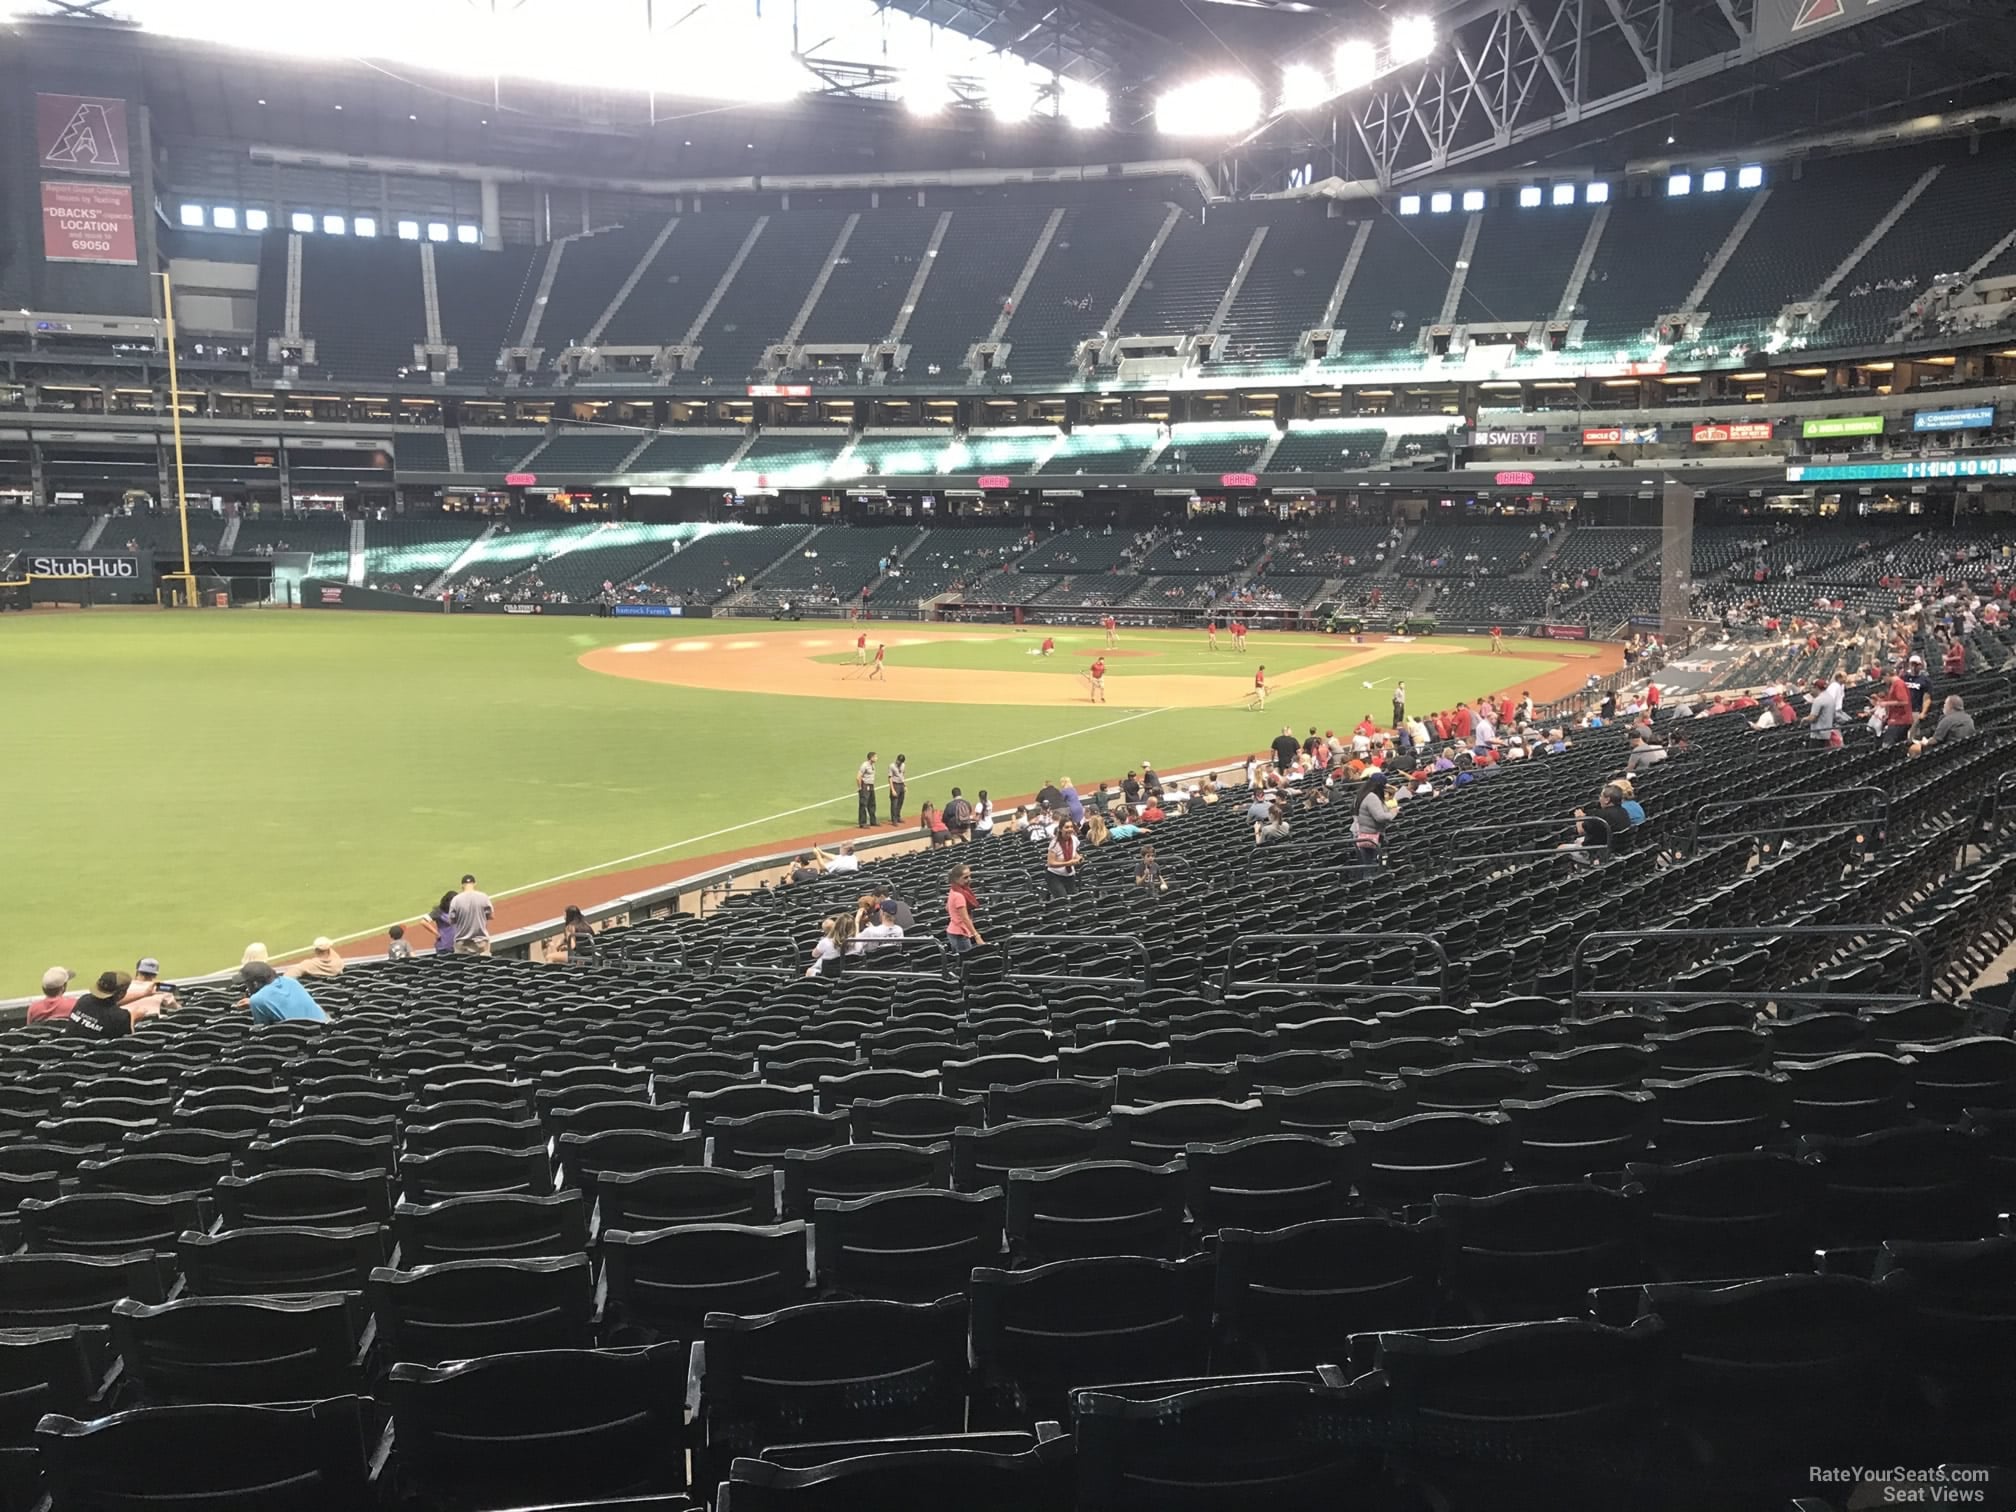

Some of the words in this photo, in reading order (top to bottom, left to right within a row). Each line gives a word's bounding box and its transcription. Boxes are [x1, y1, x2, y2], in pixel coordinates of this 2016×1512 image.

[60, 219, 119, 233] LOCATION
[71, 240, 111, 252] 69050
[1927, 410, 1991, 422] COMMONWEALTH
[34, 558, 132, 576] StubHub
